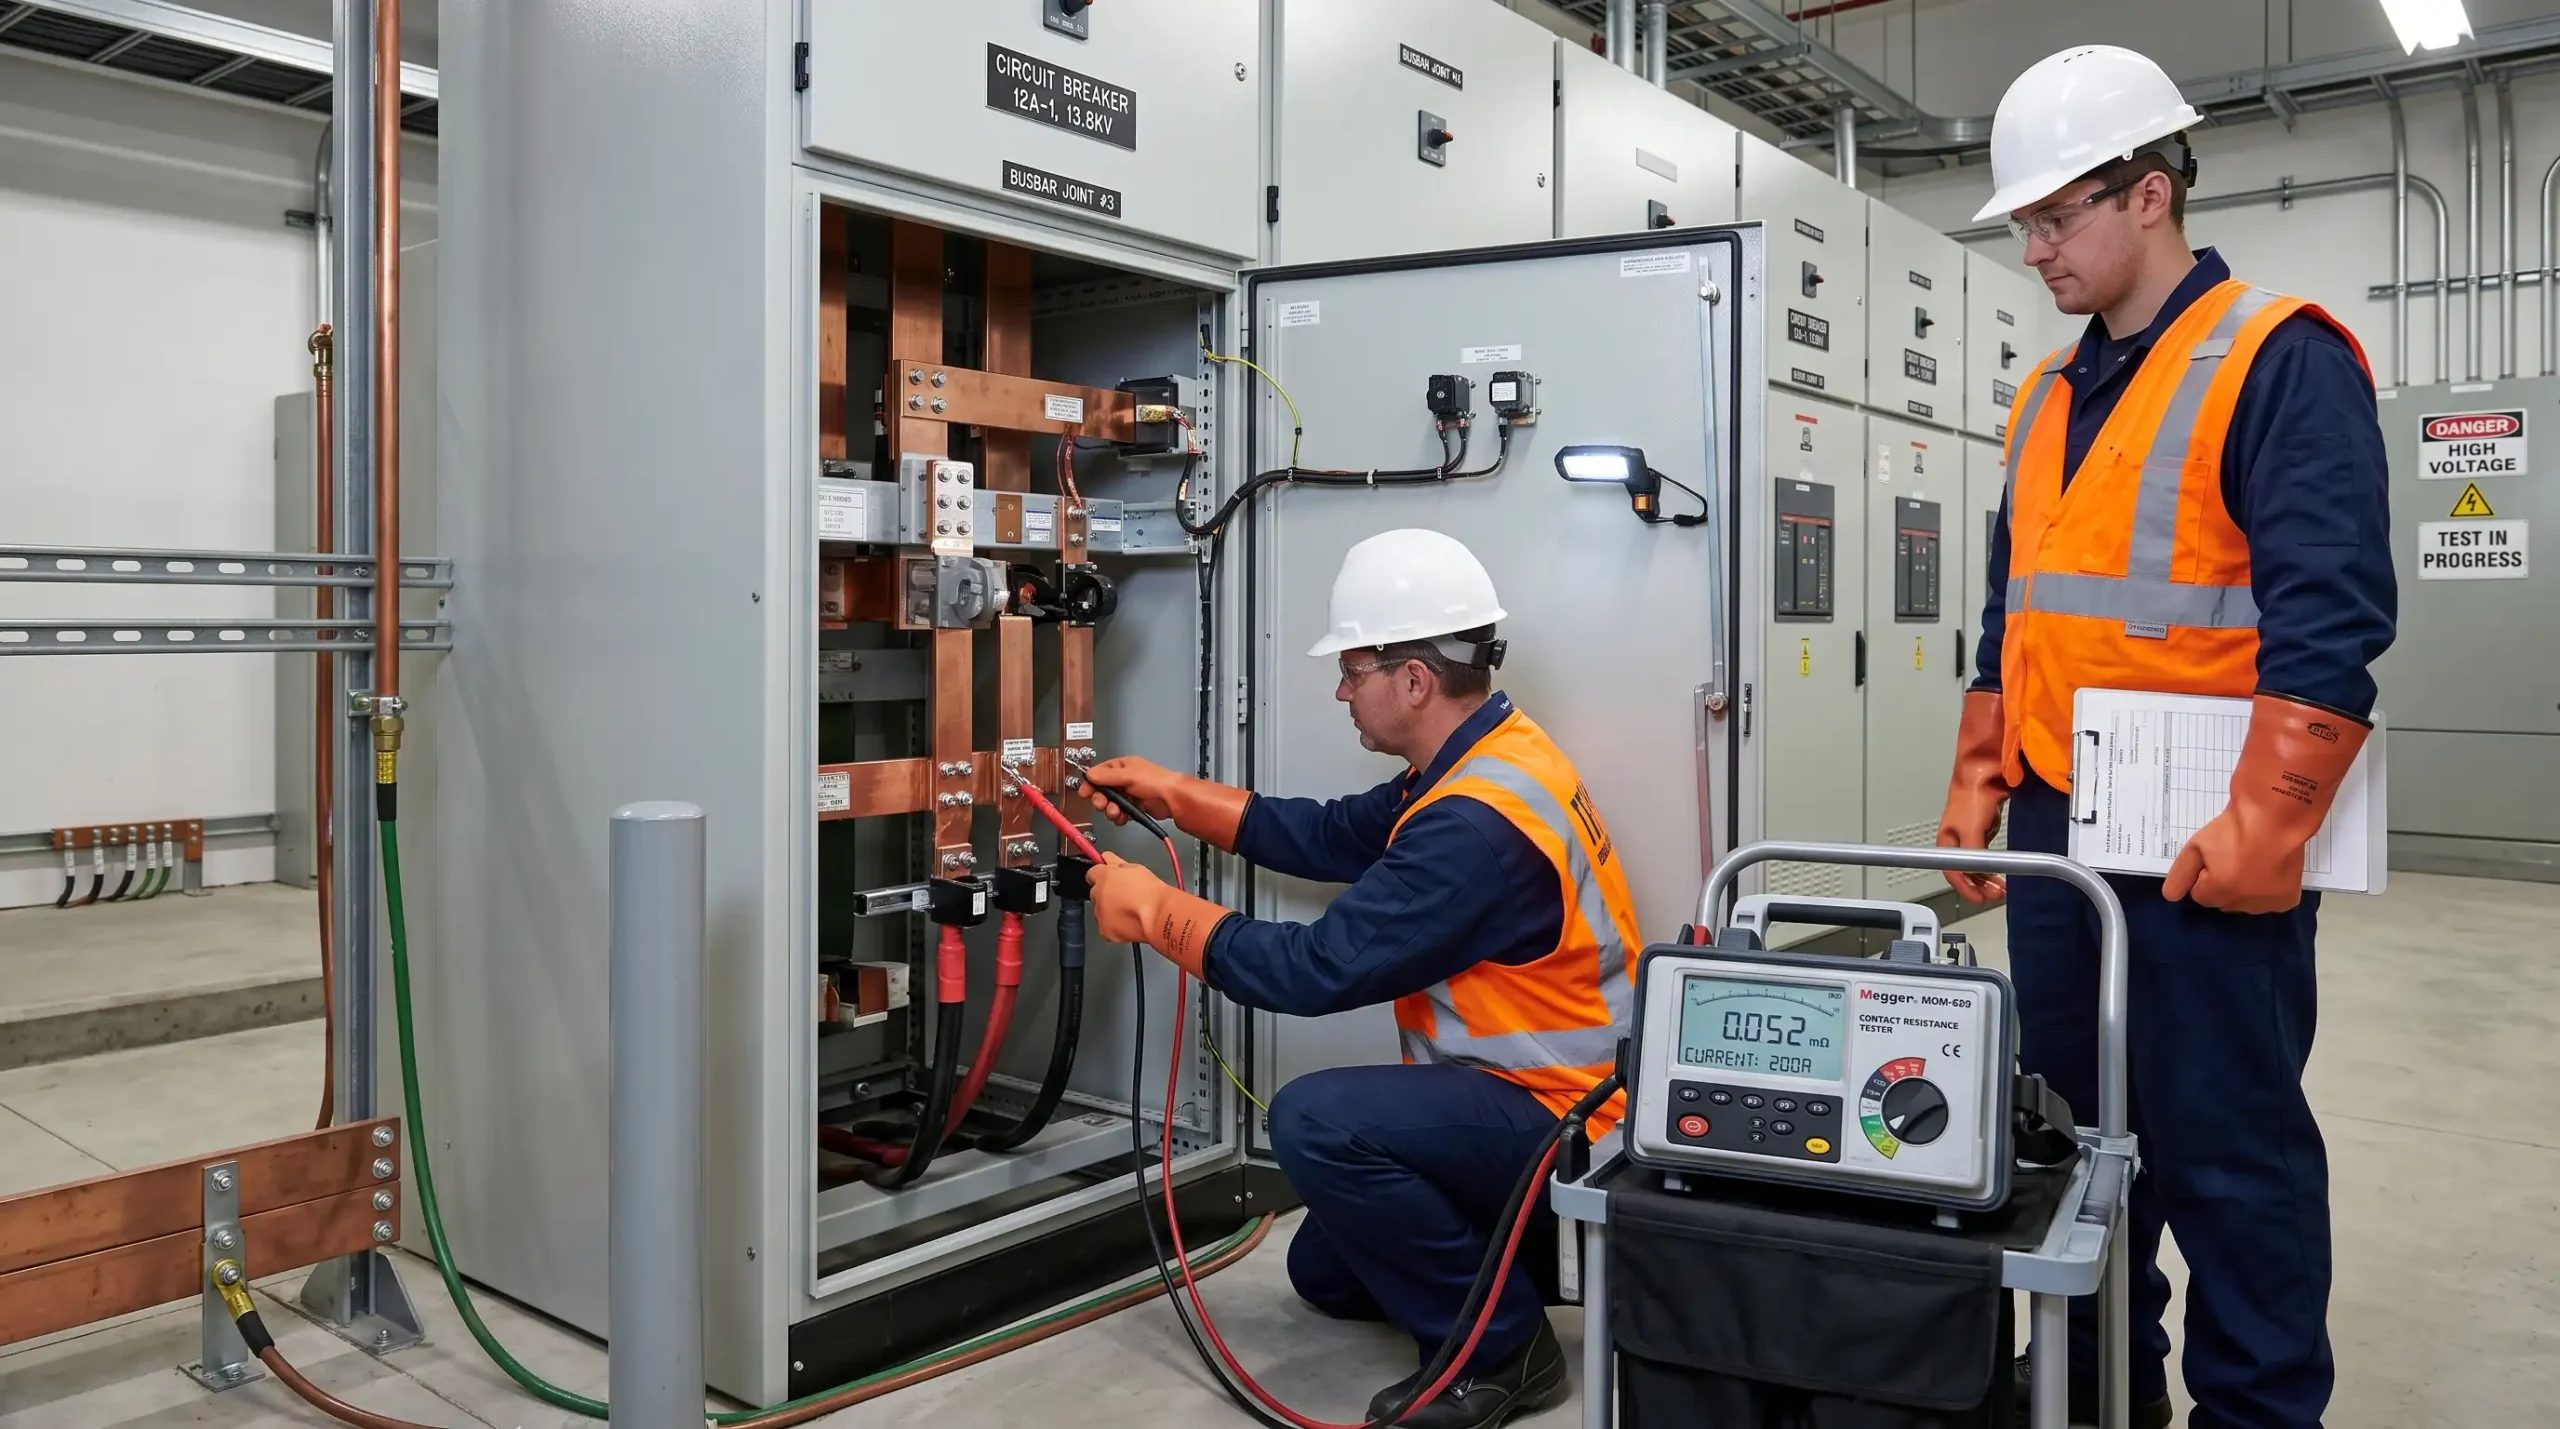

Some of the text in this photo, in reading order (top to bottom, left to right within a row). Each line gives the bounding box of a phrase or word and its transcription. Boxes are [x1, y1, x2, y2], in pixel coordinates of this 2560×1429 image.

[996, 54, 1129, 115] CIRCUIT BREAKER
[1013, 87, 1113, 135] 12A-1, 13.8KV
[1010, 168, 1057, 196] BUSBAR
[1062, 183, 1094, 205] JOINT
[2435, 419, 2509, 436] DANGER
[2448, 442, 2496, 457] HIGH
[2429, 458, 2516, 474] VOLTAGE
[2438, 530, 2507, 547] TEST IN
[2424, 551, 2522, 568] PROGRESS
[1722, 1011, 1830, 1048] 0.052 mΩ
[1859, 1014, 1959, 1029] CONTACT RESISTANCE
[1860, 1024, 1893, 1034] TESTER
[1685, 1047, 1812, 1073] CURRENT: 200A
